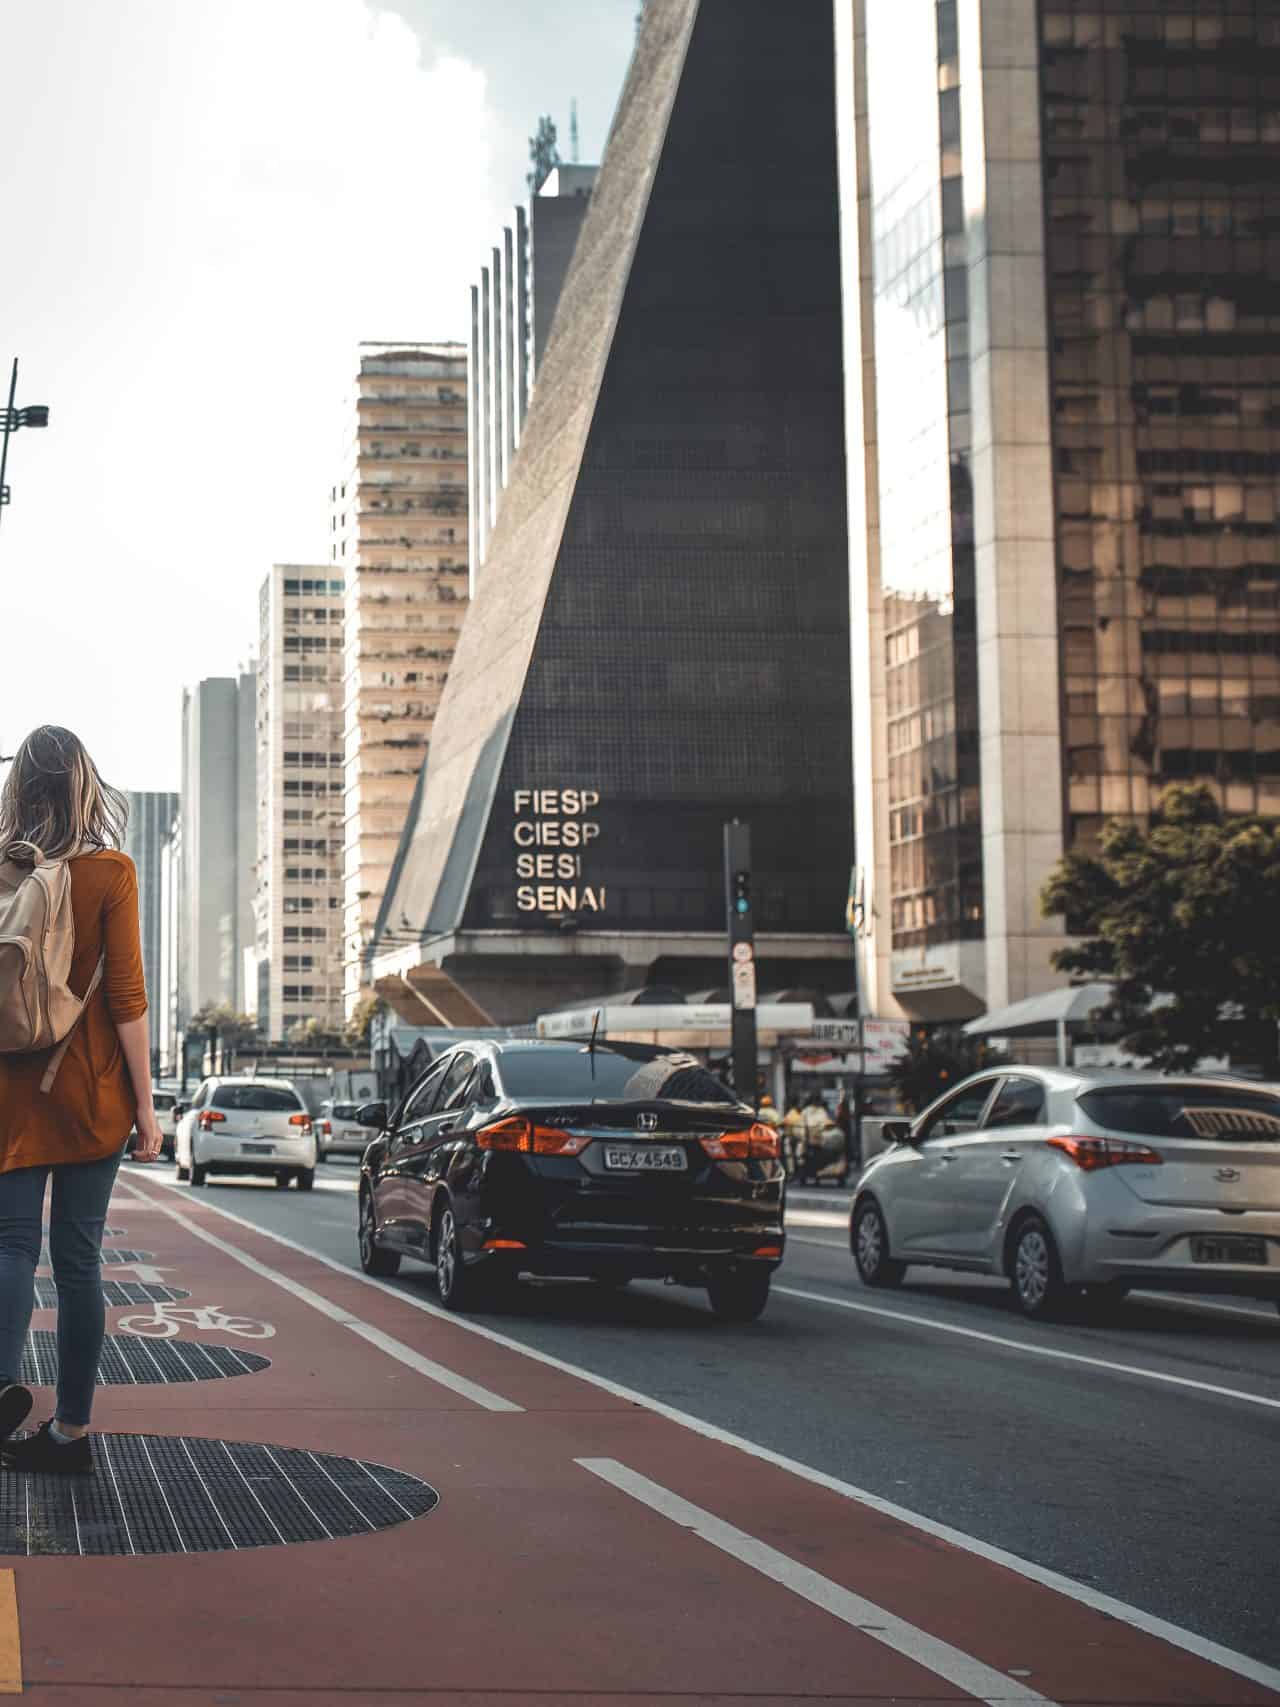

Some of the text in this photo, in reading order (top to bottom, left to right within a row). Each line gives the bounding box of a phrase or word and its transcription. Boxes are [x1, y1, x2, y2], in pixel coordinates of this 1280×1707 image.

[514, 789, 600, 815] FIESP
[513, 821, 600, 847] CIESP
[516, 853, 581, 879] SESI
[516, 885, 606, 912] SENAI
